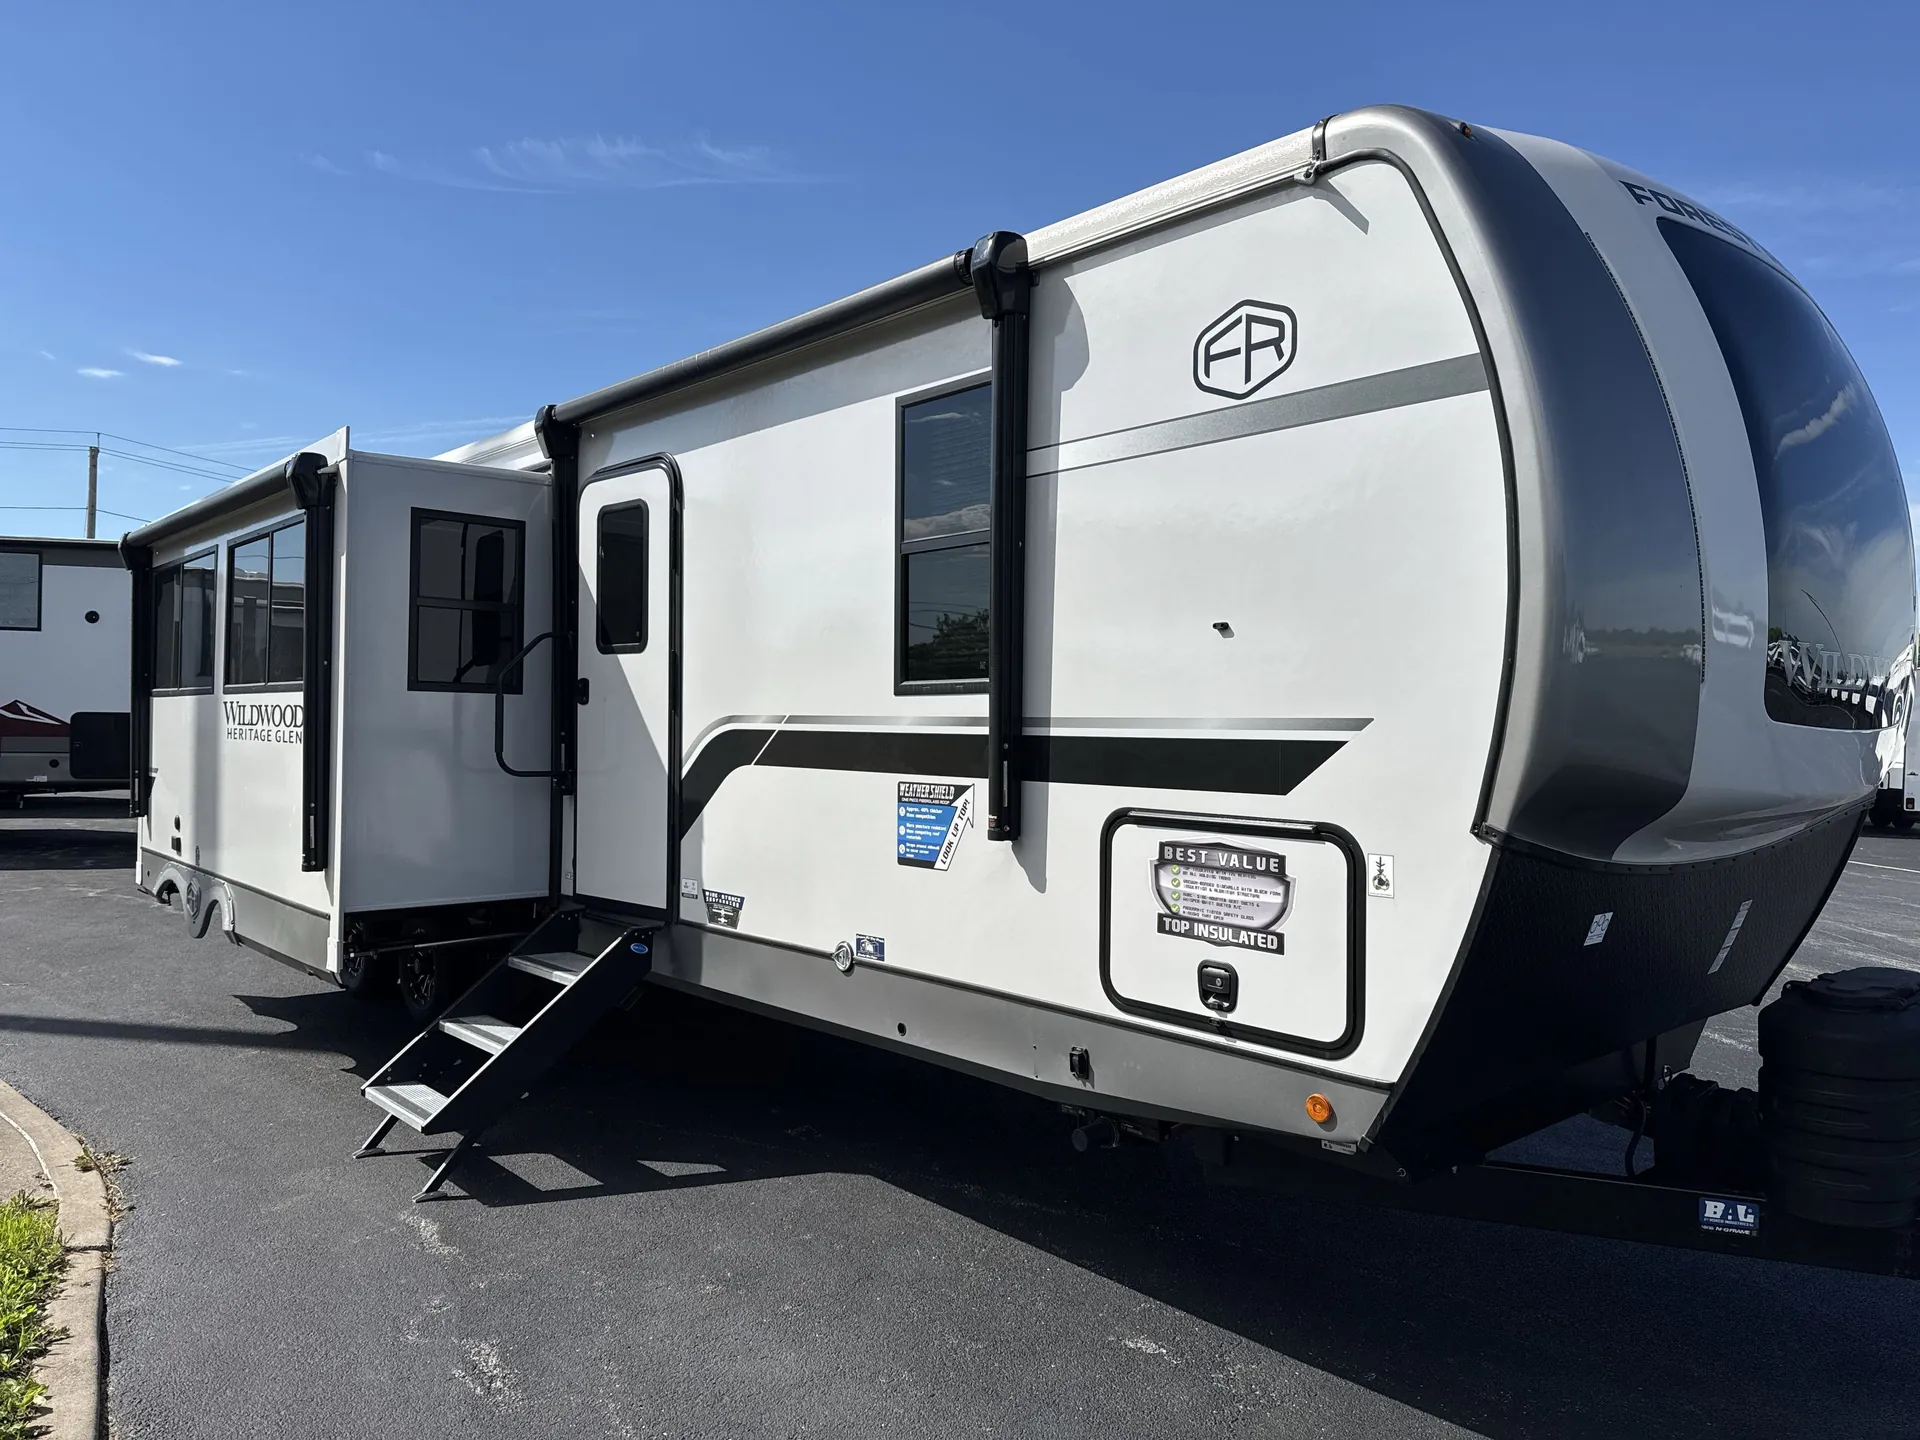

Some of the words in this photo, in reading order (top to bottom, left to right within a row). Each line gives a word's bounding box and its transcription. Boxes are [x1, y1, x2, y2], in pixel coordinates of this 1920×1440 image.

[223, 701, 304, 728] WILDWOOD
[227, 728, 272, 742] HERITAGE
[275, 730, 303, 744] GLEN
[899, 783, 930, 798] WEATHER
[930, 785, 955, 800] SHIELD
[940, 839, 954, 865] LOOK
[951, 823, 960, 838] UP
[958, 798, 971, 821] TOP!
[1164, 846, 1208, 864] BEST
[1218, 852, 1280, 872] VALUE
[1163, 917, 1190, 934] TOP
[1193, 922, 1278, 950] INSULATED
[1704, 1200, 1755, 1223] BAL
